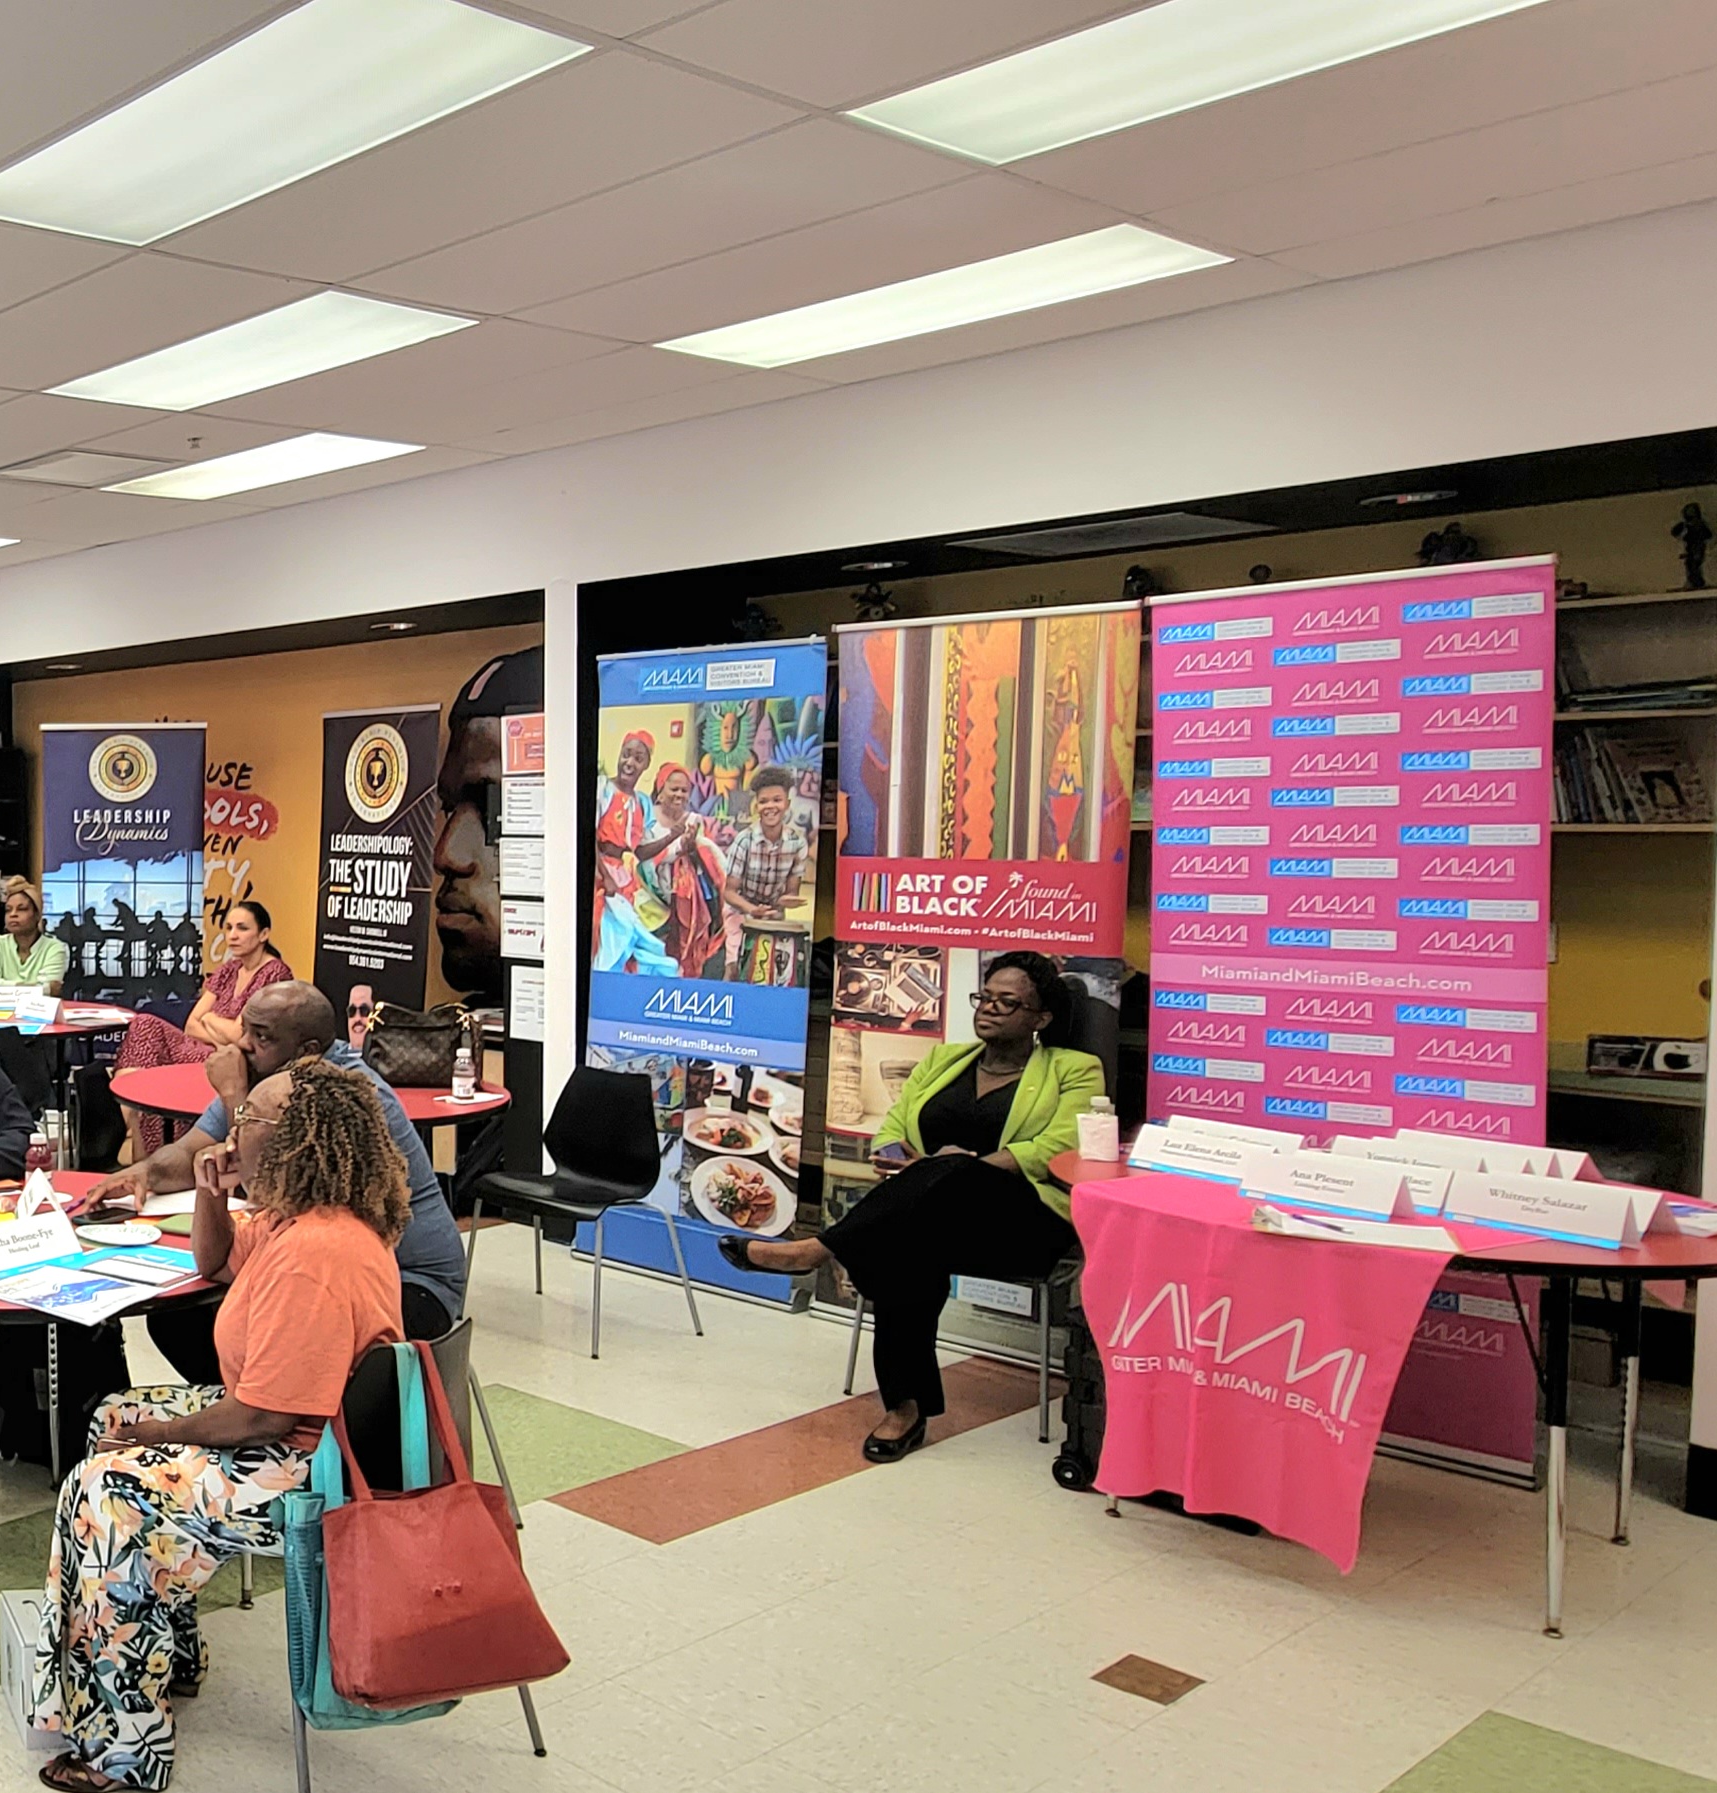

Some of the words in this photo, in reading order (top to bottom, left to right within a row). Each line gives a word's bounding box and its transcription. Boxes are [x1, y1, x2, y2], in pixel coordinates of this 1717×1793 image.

[74, 809, 171, 825] LEADERSHIP
[76, 815, 169, 856] Dynamics
[330, 833, 414, 856] LEADERSHIPOLOGY:
[329, 859, 352, 884] THE
[353, 859, 412, 898] STUDY
[895, 873, 945, 893] ART
[952, 875, 988, 895] OF
[1015, 879, 1074, 903] found
[327, 895, 343, 918] OF
[344, 897, 413, 925] LEADERSHIP
[896, 895, 979, 917] BLACK
[995, 899, 1097, 923] MIAMI
[850, 920, 972, 936] ArtofBlackMiami.com
[981, 927, 1095, 943] #ArtofBlackMiami
[1201, 964, 1473, 993] MiamiandMiamiBeach.com
[644, 988, 733, 1019] MIAMI
[619, 1030, 758, 1057] MiamiandMiamiBeach.com
[1290, 1169, 1313, 1181] Ana
[1489, 1188, 1539, 1206] Whitney
[1542, 1196, 1588, 1212] Salazar
[12, 1228, 54, 1245] Boone-Fye
[1108, 1282, 1367, 1423] MIAMI
[1212, 1372, 1279, 1404] MIAMI
[1285, 1393, 1345, 1445] BEACH
